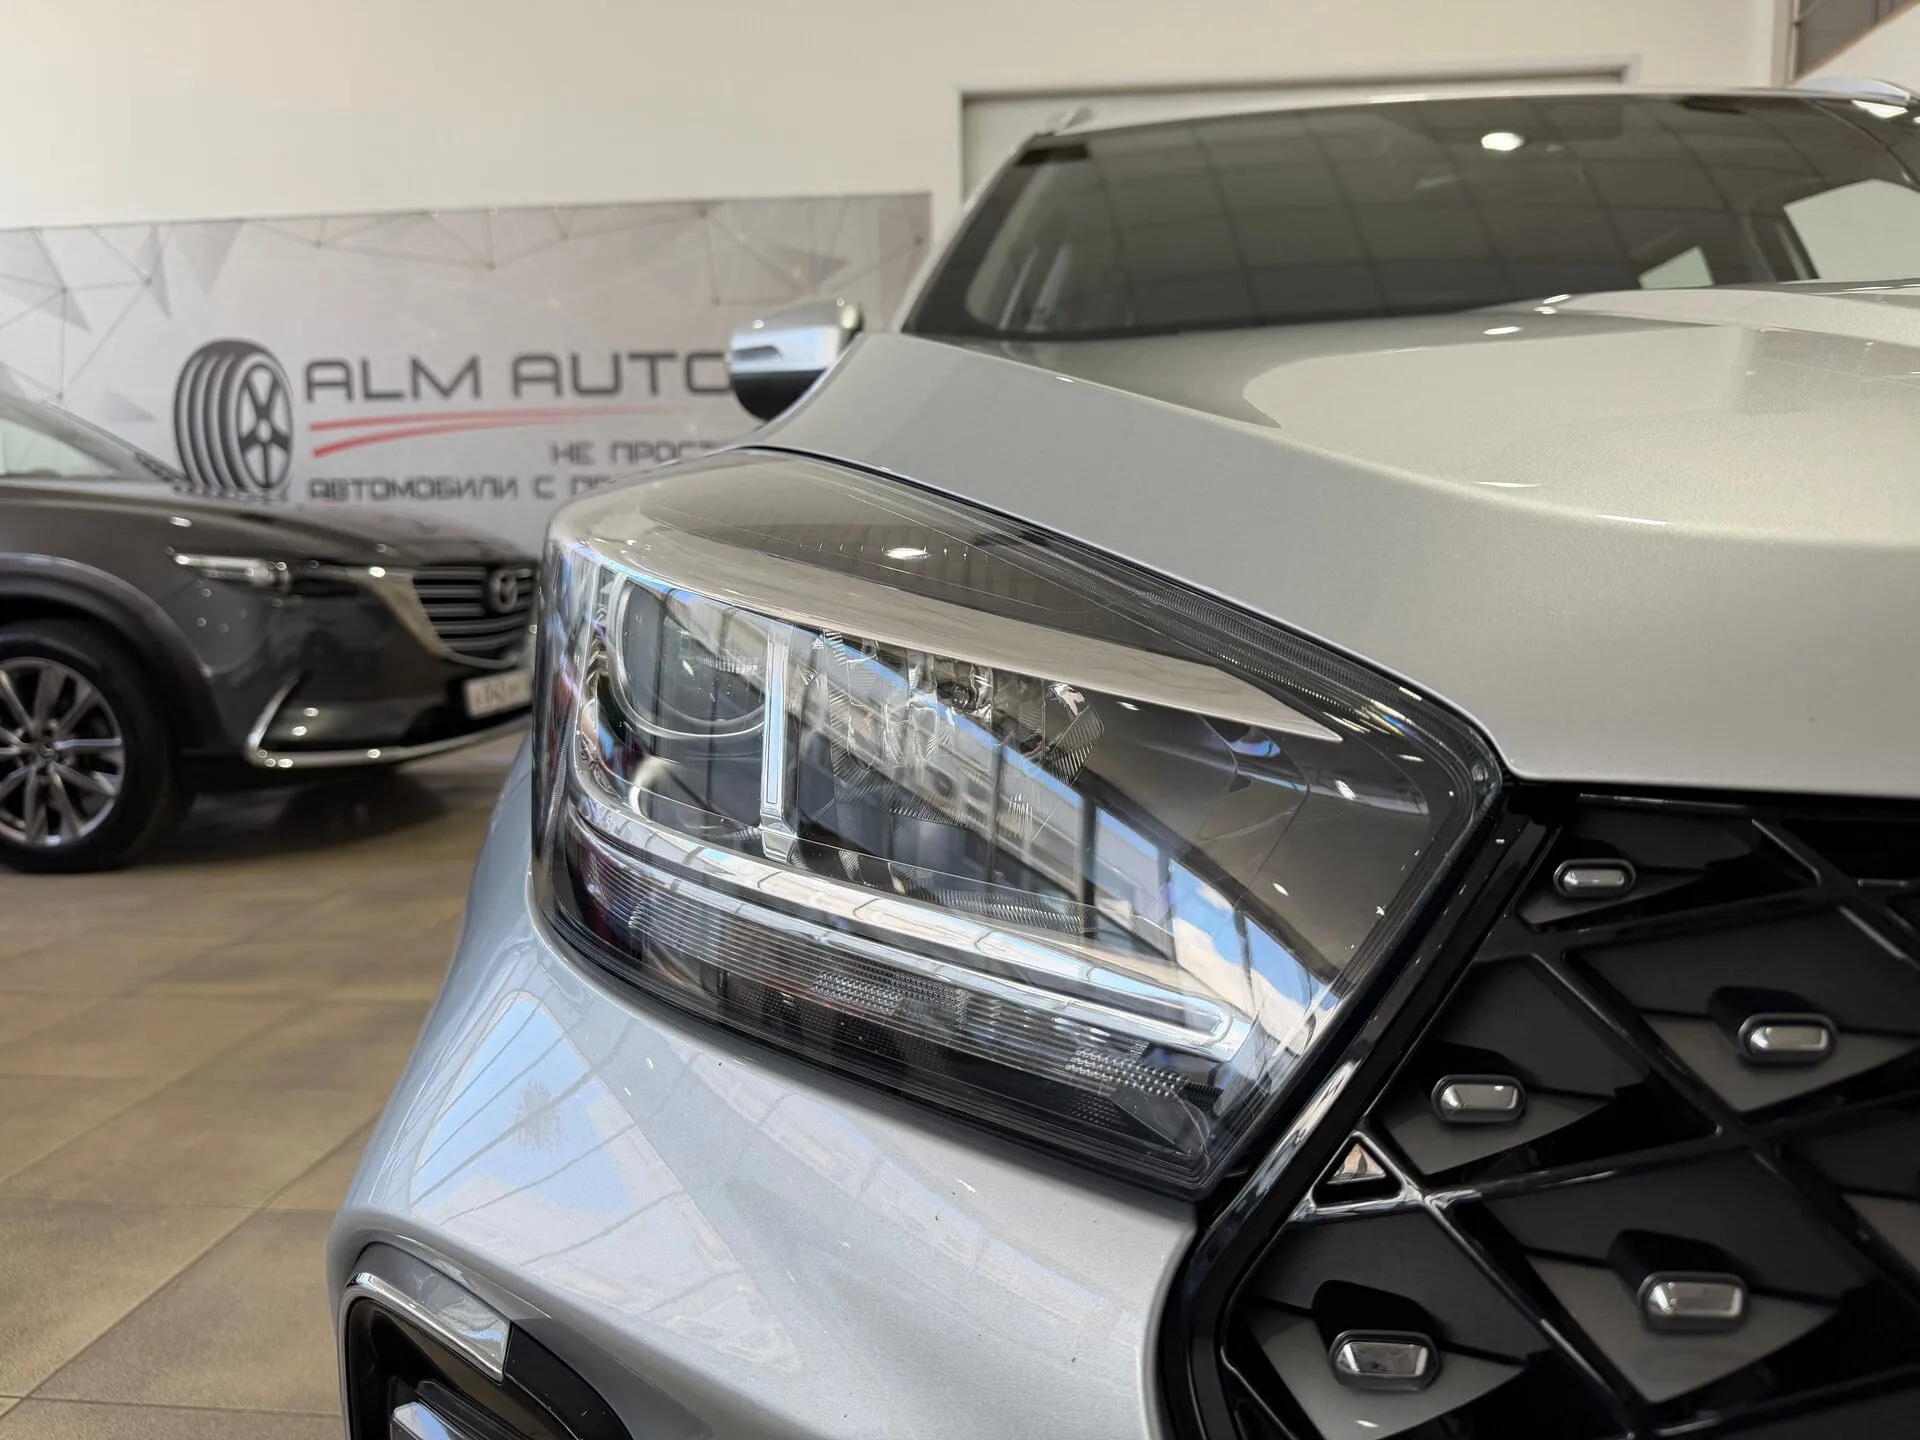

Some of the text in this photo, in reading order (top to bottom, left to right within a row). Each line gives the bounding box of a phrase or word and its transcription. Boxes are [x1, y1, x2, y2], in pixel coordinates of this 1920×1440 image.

[305, 351, 731, 402] ALM AUTO
[551, 440, 595, 465] НЕ
[309, 475, 518, 500] АВТОМОБИЛИ
